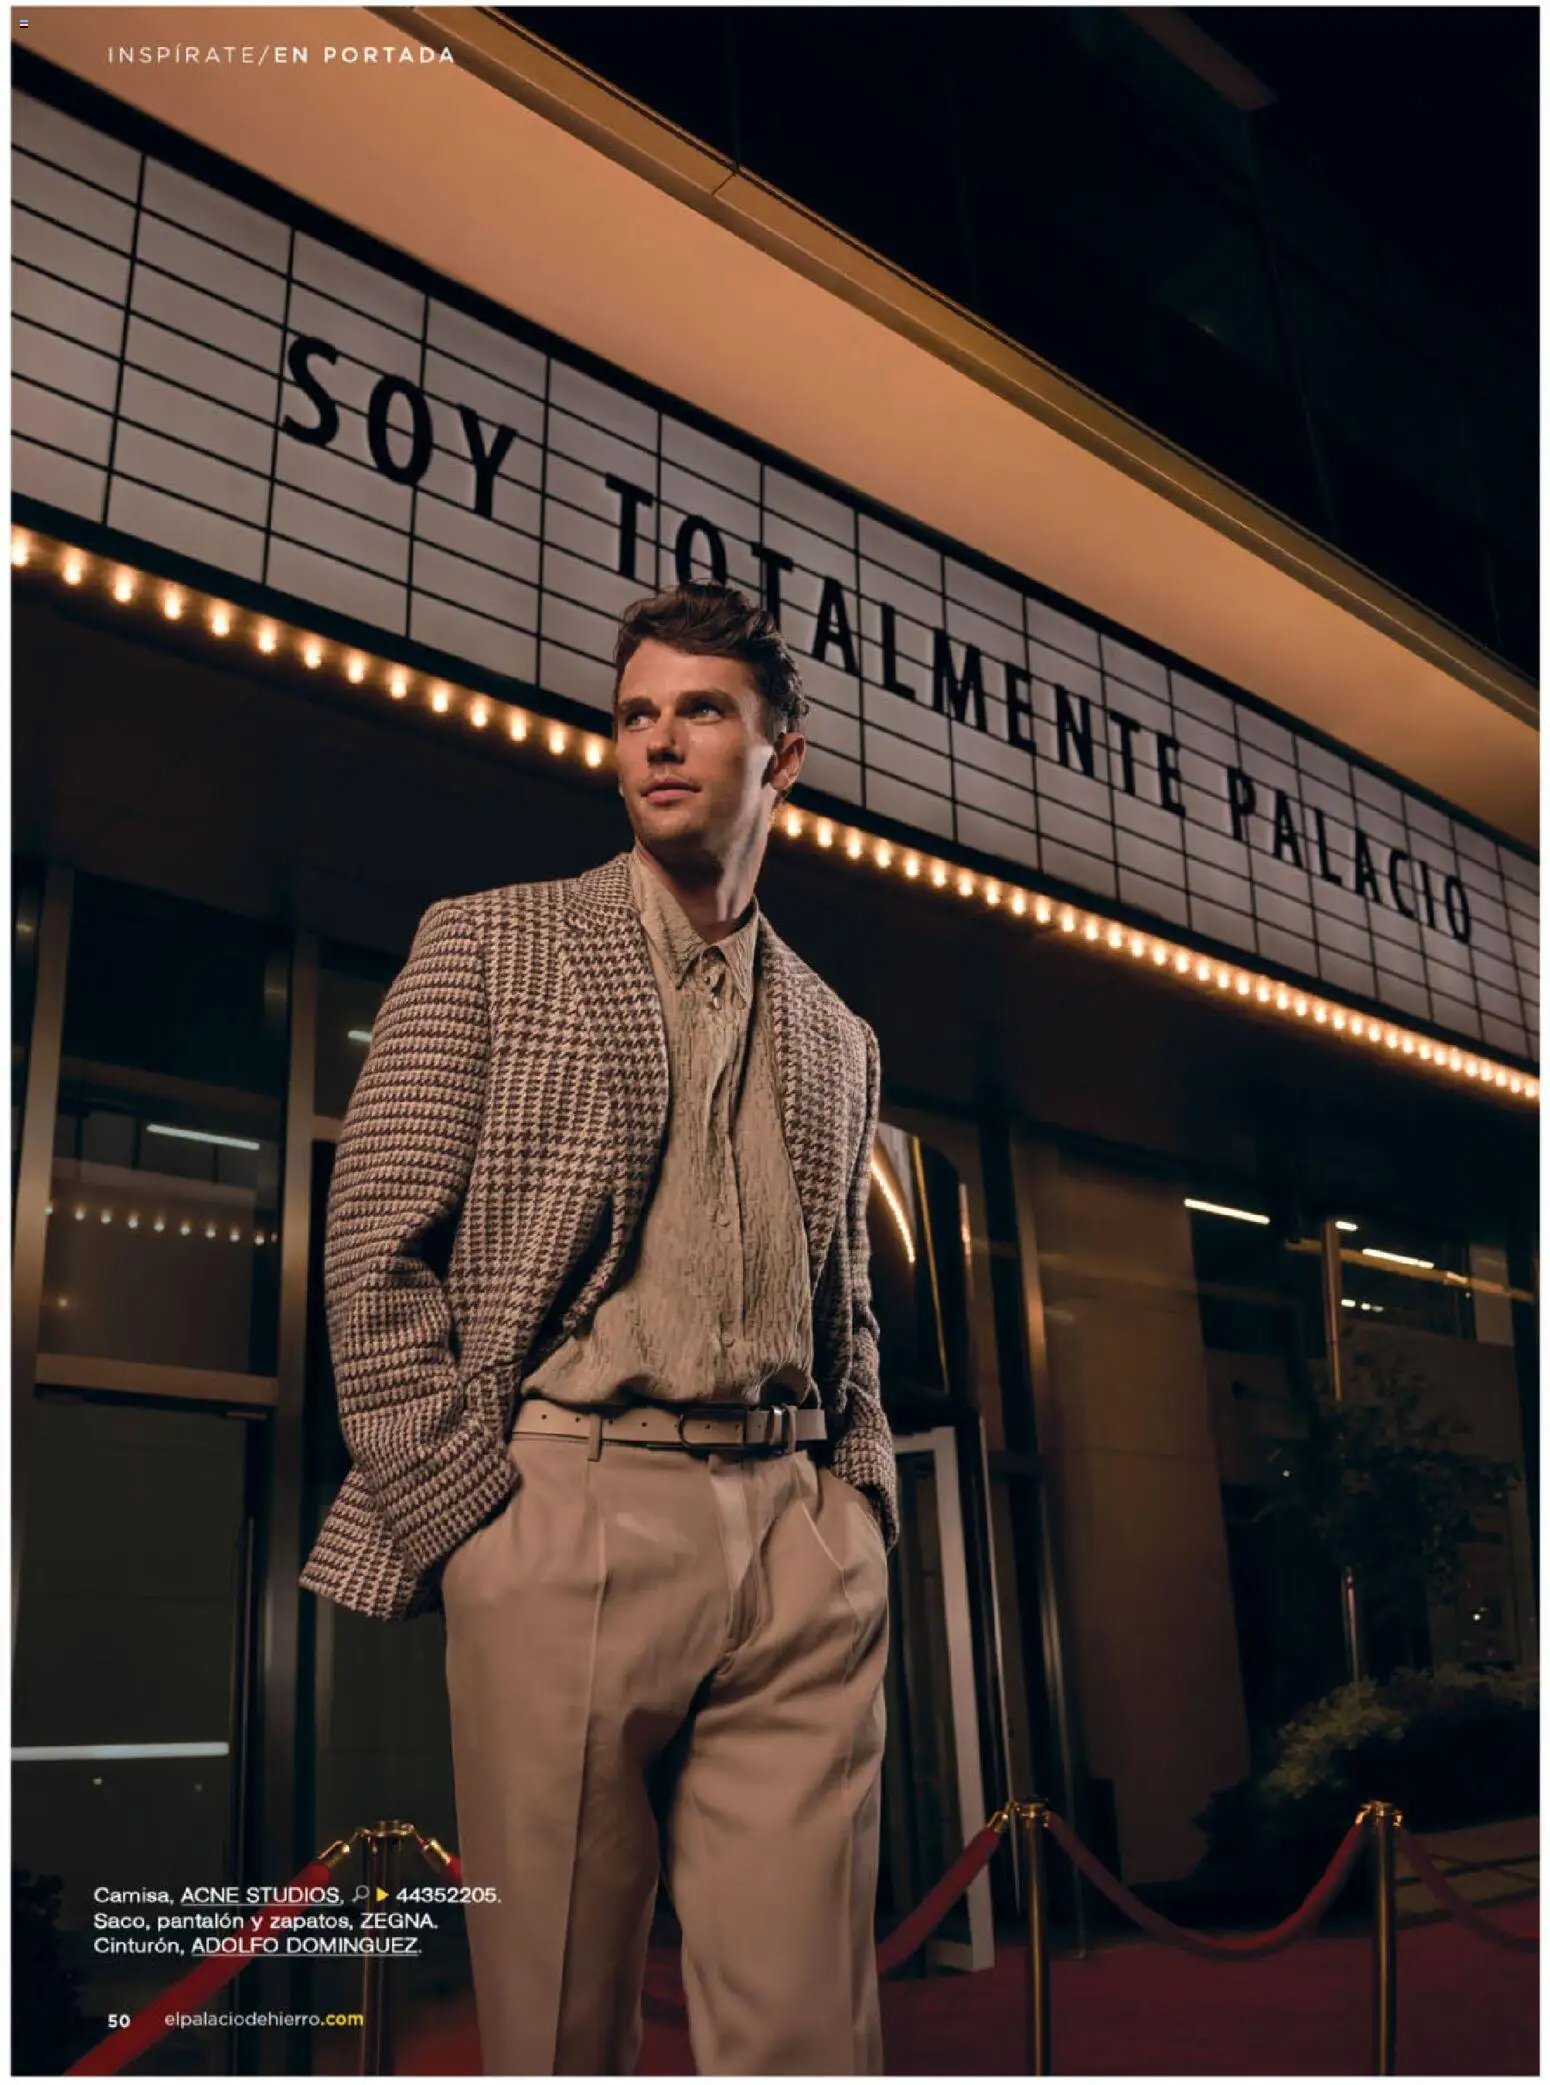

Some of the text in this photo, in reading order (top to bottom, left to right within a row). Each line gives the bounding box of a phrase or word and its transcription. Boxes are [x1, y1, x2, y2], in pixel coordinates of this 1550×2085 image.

[282, 335, 1473, 945] SOY TOTALMENTE PALACIO
